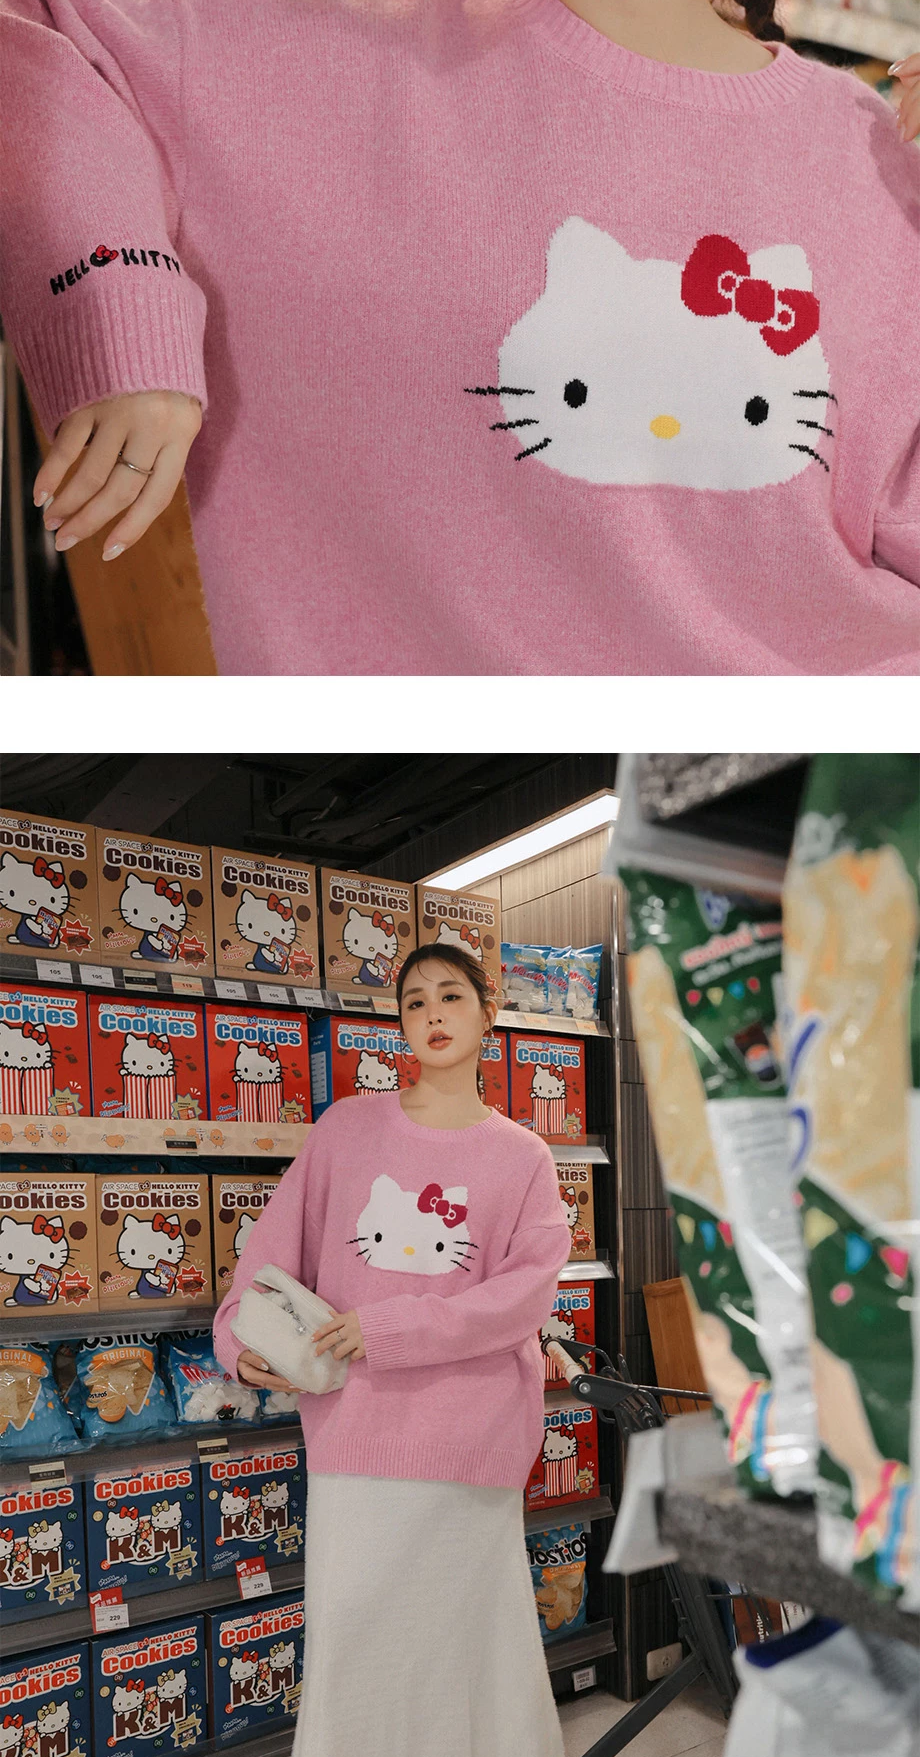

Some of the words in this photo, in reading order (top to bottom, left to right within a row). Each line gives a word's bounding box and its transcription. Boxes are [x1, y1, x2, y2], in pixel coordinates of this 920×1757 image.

[121, 248, 180, 277] KITTY
[106, 848, 201, 878] Cookies
[154, 846, 175, 856] HELLO
[176, 850, 200, 861] KITTY
[224, 865, 309, 895] Cookies
[331, 885, 409, 912] Cookies
[100, 1013, 195, 1037] Cookies
[217, 1023, 301, 1045] Cookies
[517, 1048, 580, 1067] Cookies
[103, 1192, 199, 1209] Cookies
[212, 1453, 298, 1480] Cookies
[96, 1475, 191, 1500] Cookies
[222, 1508, 288, 1538] K&M
[108, 1528, 180, 1562] K&M
[109, 1614, 121, 1622] 229
[221, 1613, 304, 1647] Cookies
[103, 1638, 195, 1676] Cookies
[232, 1667, 295, 1706] K&M
[113, 1700, 186, 1741] K&M
